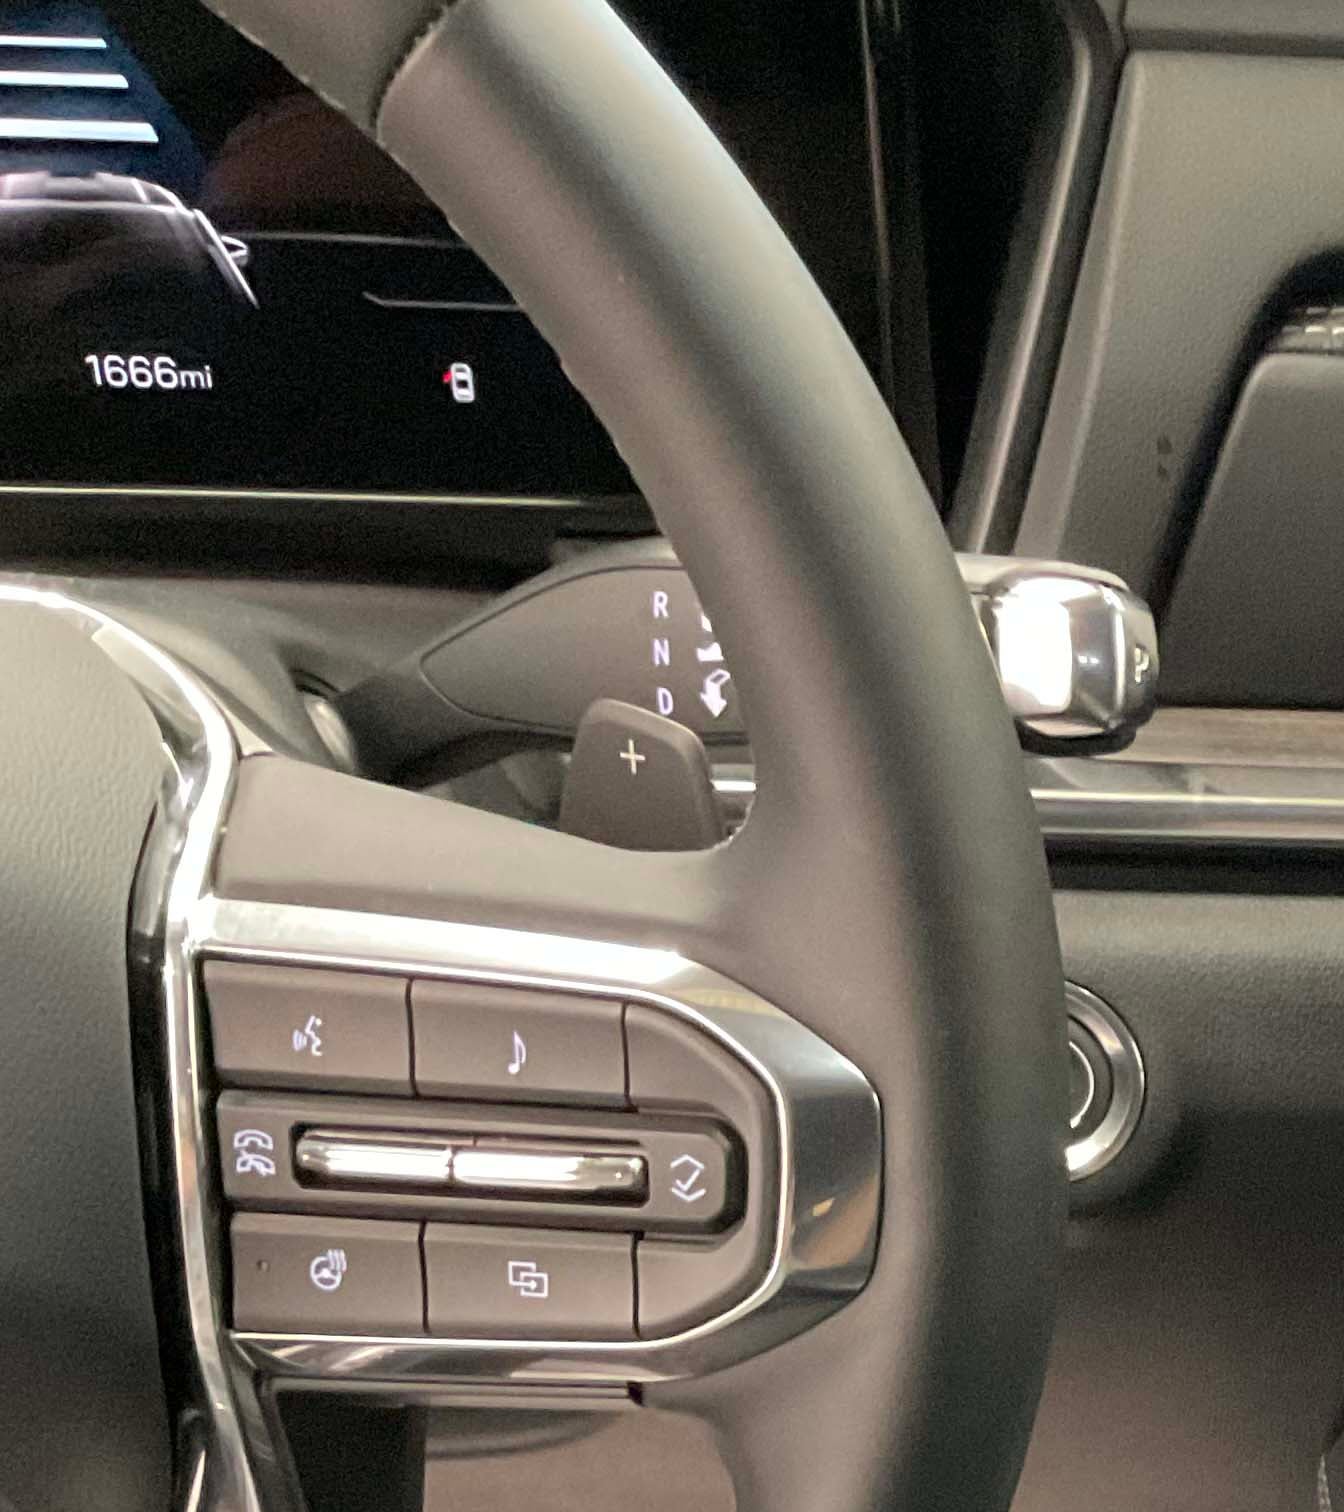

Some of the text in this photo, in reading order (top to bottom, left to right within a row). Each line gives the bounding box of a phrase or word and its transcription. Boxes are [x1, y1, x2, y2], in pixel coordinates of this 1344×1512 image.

[653, 591, 669, 618] R
[653, 638, 670, 666] N
[656, 687, 673, 715] D
